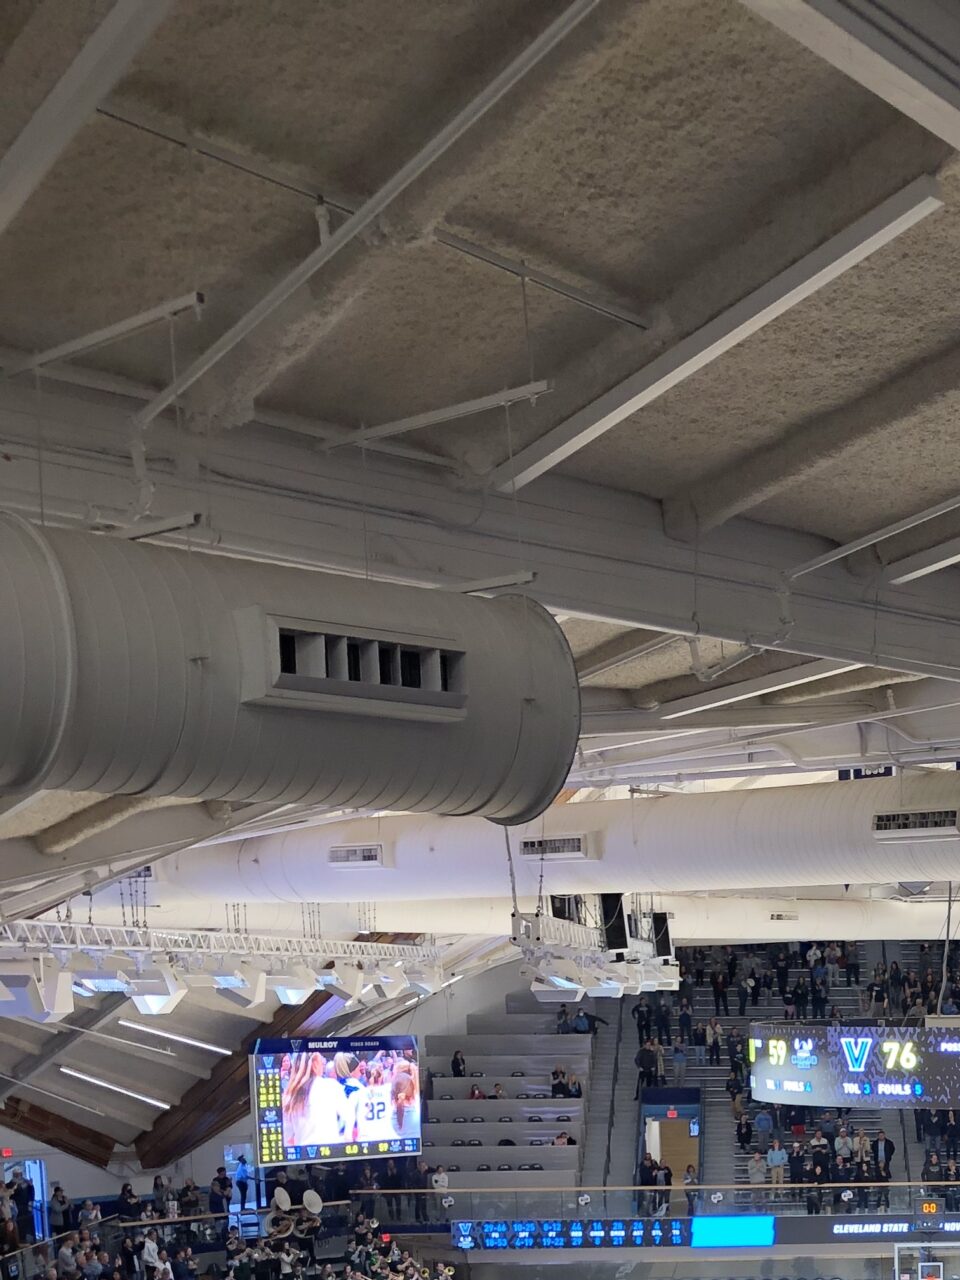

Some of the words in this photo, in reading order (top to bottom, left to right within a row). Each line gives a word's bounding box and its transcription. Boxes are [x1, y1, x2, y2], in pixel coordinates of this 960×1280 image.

[768, 1040, 786, 1066] 59
[882, 1042, 917, 1069] 76
[843, 1083, 860, 1094] TOL
[864, 1083, 871, 1094] 3
[878, 1083, 911, 1095] FOULS
[914, 1085, 922, 1095] 5
[365, 1102, 385, 1120] 32
[320, 1146, 330, 1156] 76
[833, 1224, 881, 1234] CLEVELAND
[883, 1223, 908, 1232] STATE
